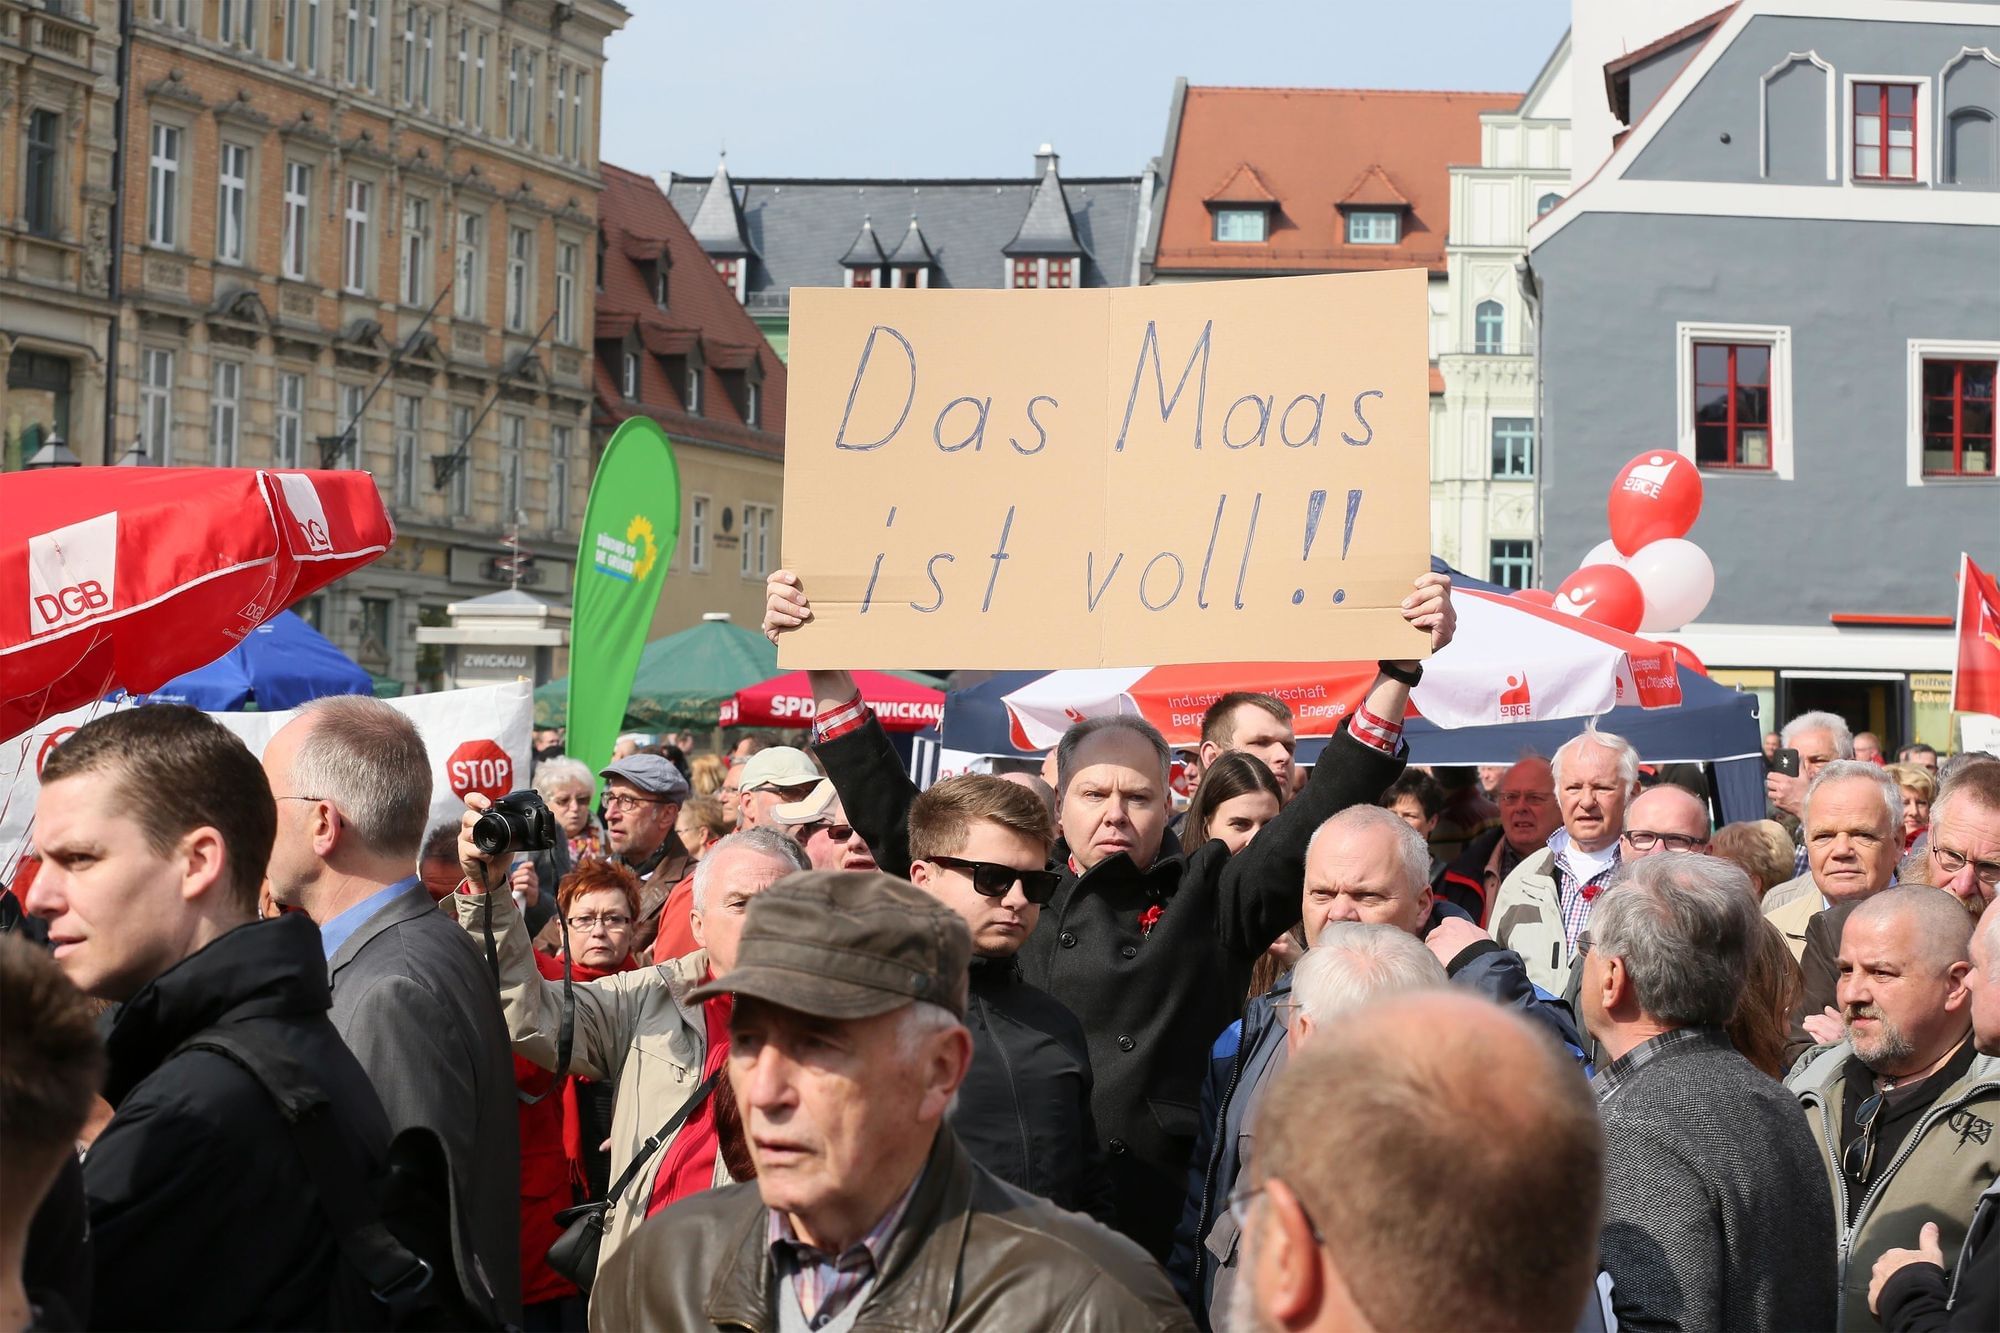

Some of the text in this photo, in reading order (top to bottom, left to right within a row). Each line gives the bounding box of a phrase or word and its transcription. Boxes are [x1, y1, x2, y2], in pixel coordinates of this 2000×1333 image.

[835, 318, 1385, 455] Das Maas
[1631, 478, 1661, 500] BCE
[859, 504, 1015, 614] ist
[34, 580, 108, 624] DGB
[463, 654, 527, 668] ZWICKAU
[769, 694, 816, 718] SPD
[1300, 702, 1346, 718] Energie
[1510, 704, 1531, 717] BCE
[452, 758, 509, 790] STOP
